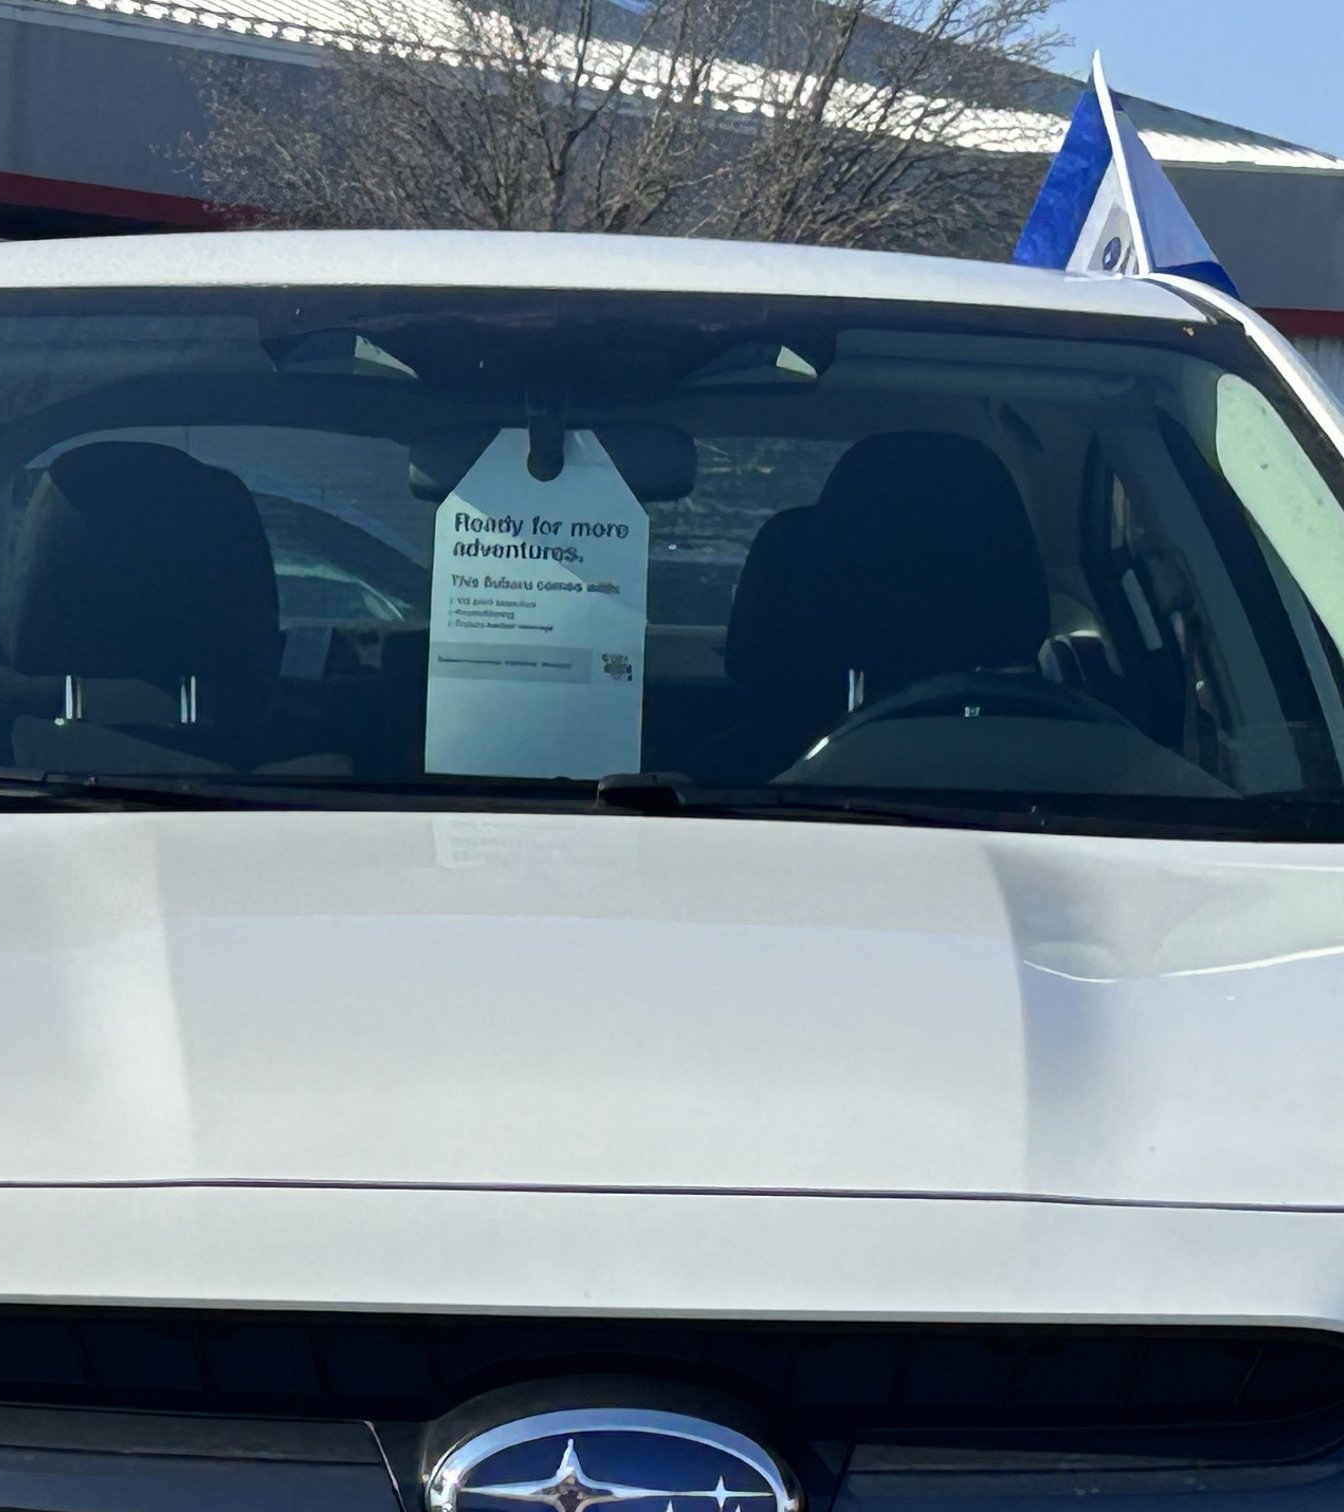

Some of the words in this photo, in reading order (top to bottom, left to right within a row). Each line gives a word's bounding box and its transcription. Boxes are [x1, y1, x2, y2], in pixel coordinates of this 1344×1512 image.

[454, 512, 523, 537] Ready
[532, 515, 563, 535] for
[570, 521, 629, 539] more
